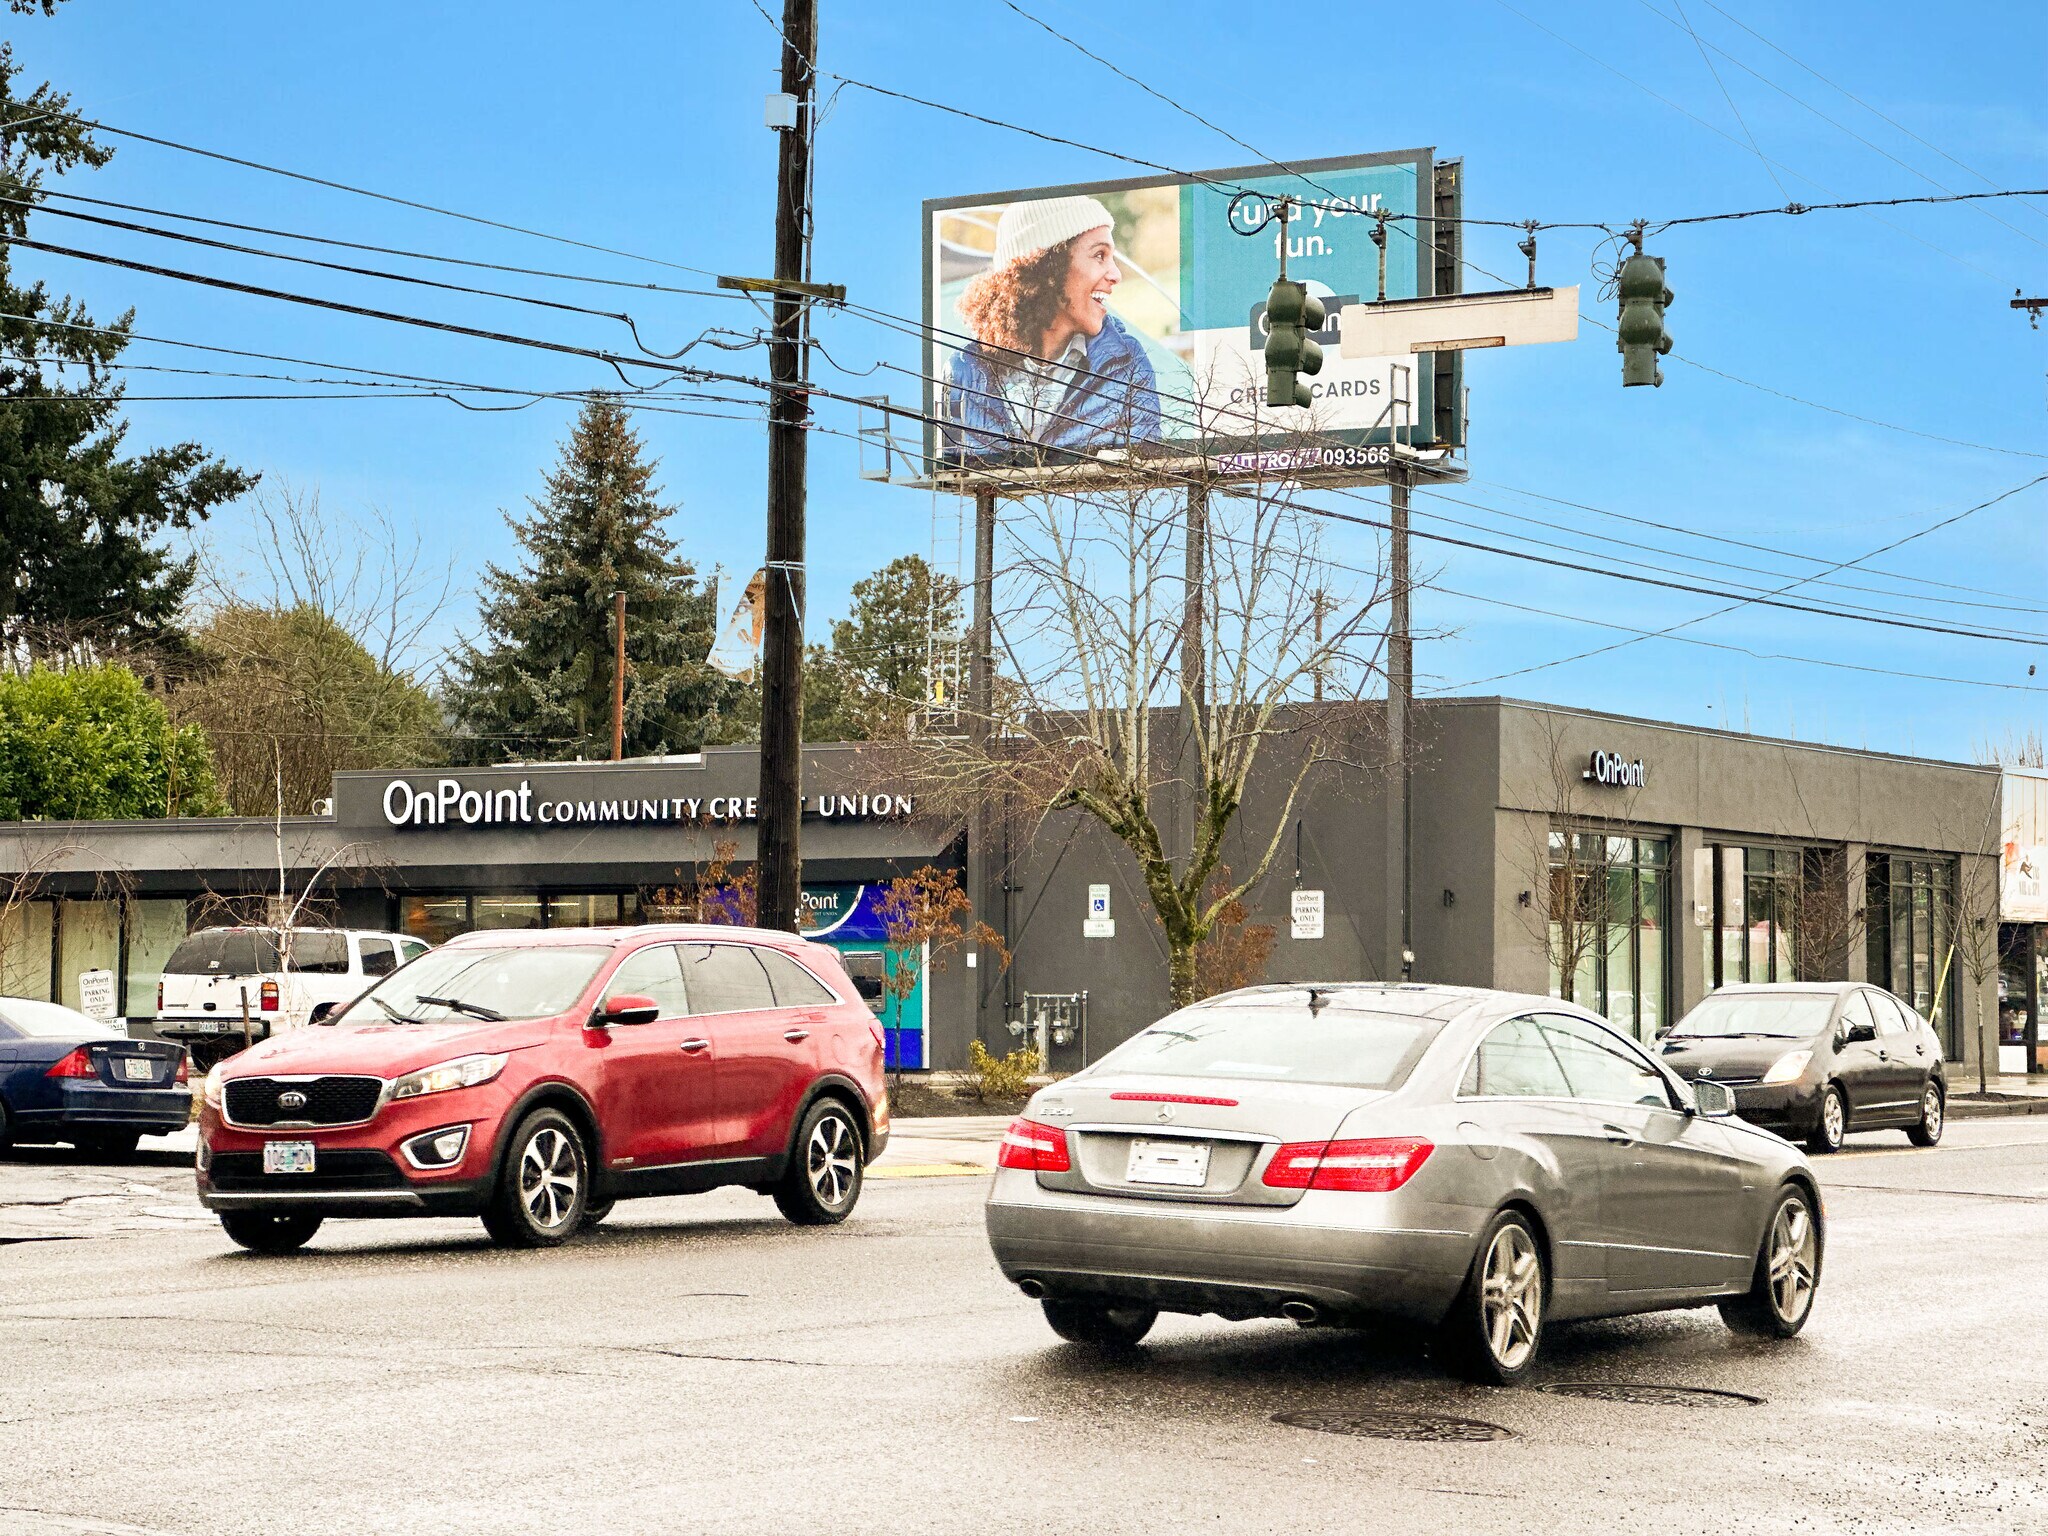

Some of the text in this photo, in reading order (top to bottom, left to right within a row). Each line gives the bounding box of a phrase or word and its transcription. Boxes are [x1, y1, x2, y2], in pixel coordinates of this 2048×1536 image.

[1312, 193, 1382, 228] your
[1274, 231, 1334, 259] fun.
[1310, 378, 1380, 399] CARDS
[1323, 446, 1390, 465] 093566
[1595, 749, 1645, 788] OnPoint
[383, 778, 533, 825] OnPoint
[538, 798, 701, 822] COMMUNITY
[818, 794, 913, 816] UNION
[802, 891, 839, 910] Point
[1294, 906, 1321, 914] PARKING
[82, 976, 110, 986] OnPoint
[84, 988, 111, 997] PARKING
[281, 1095, 301, 1107] KIA
